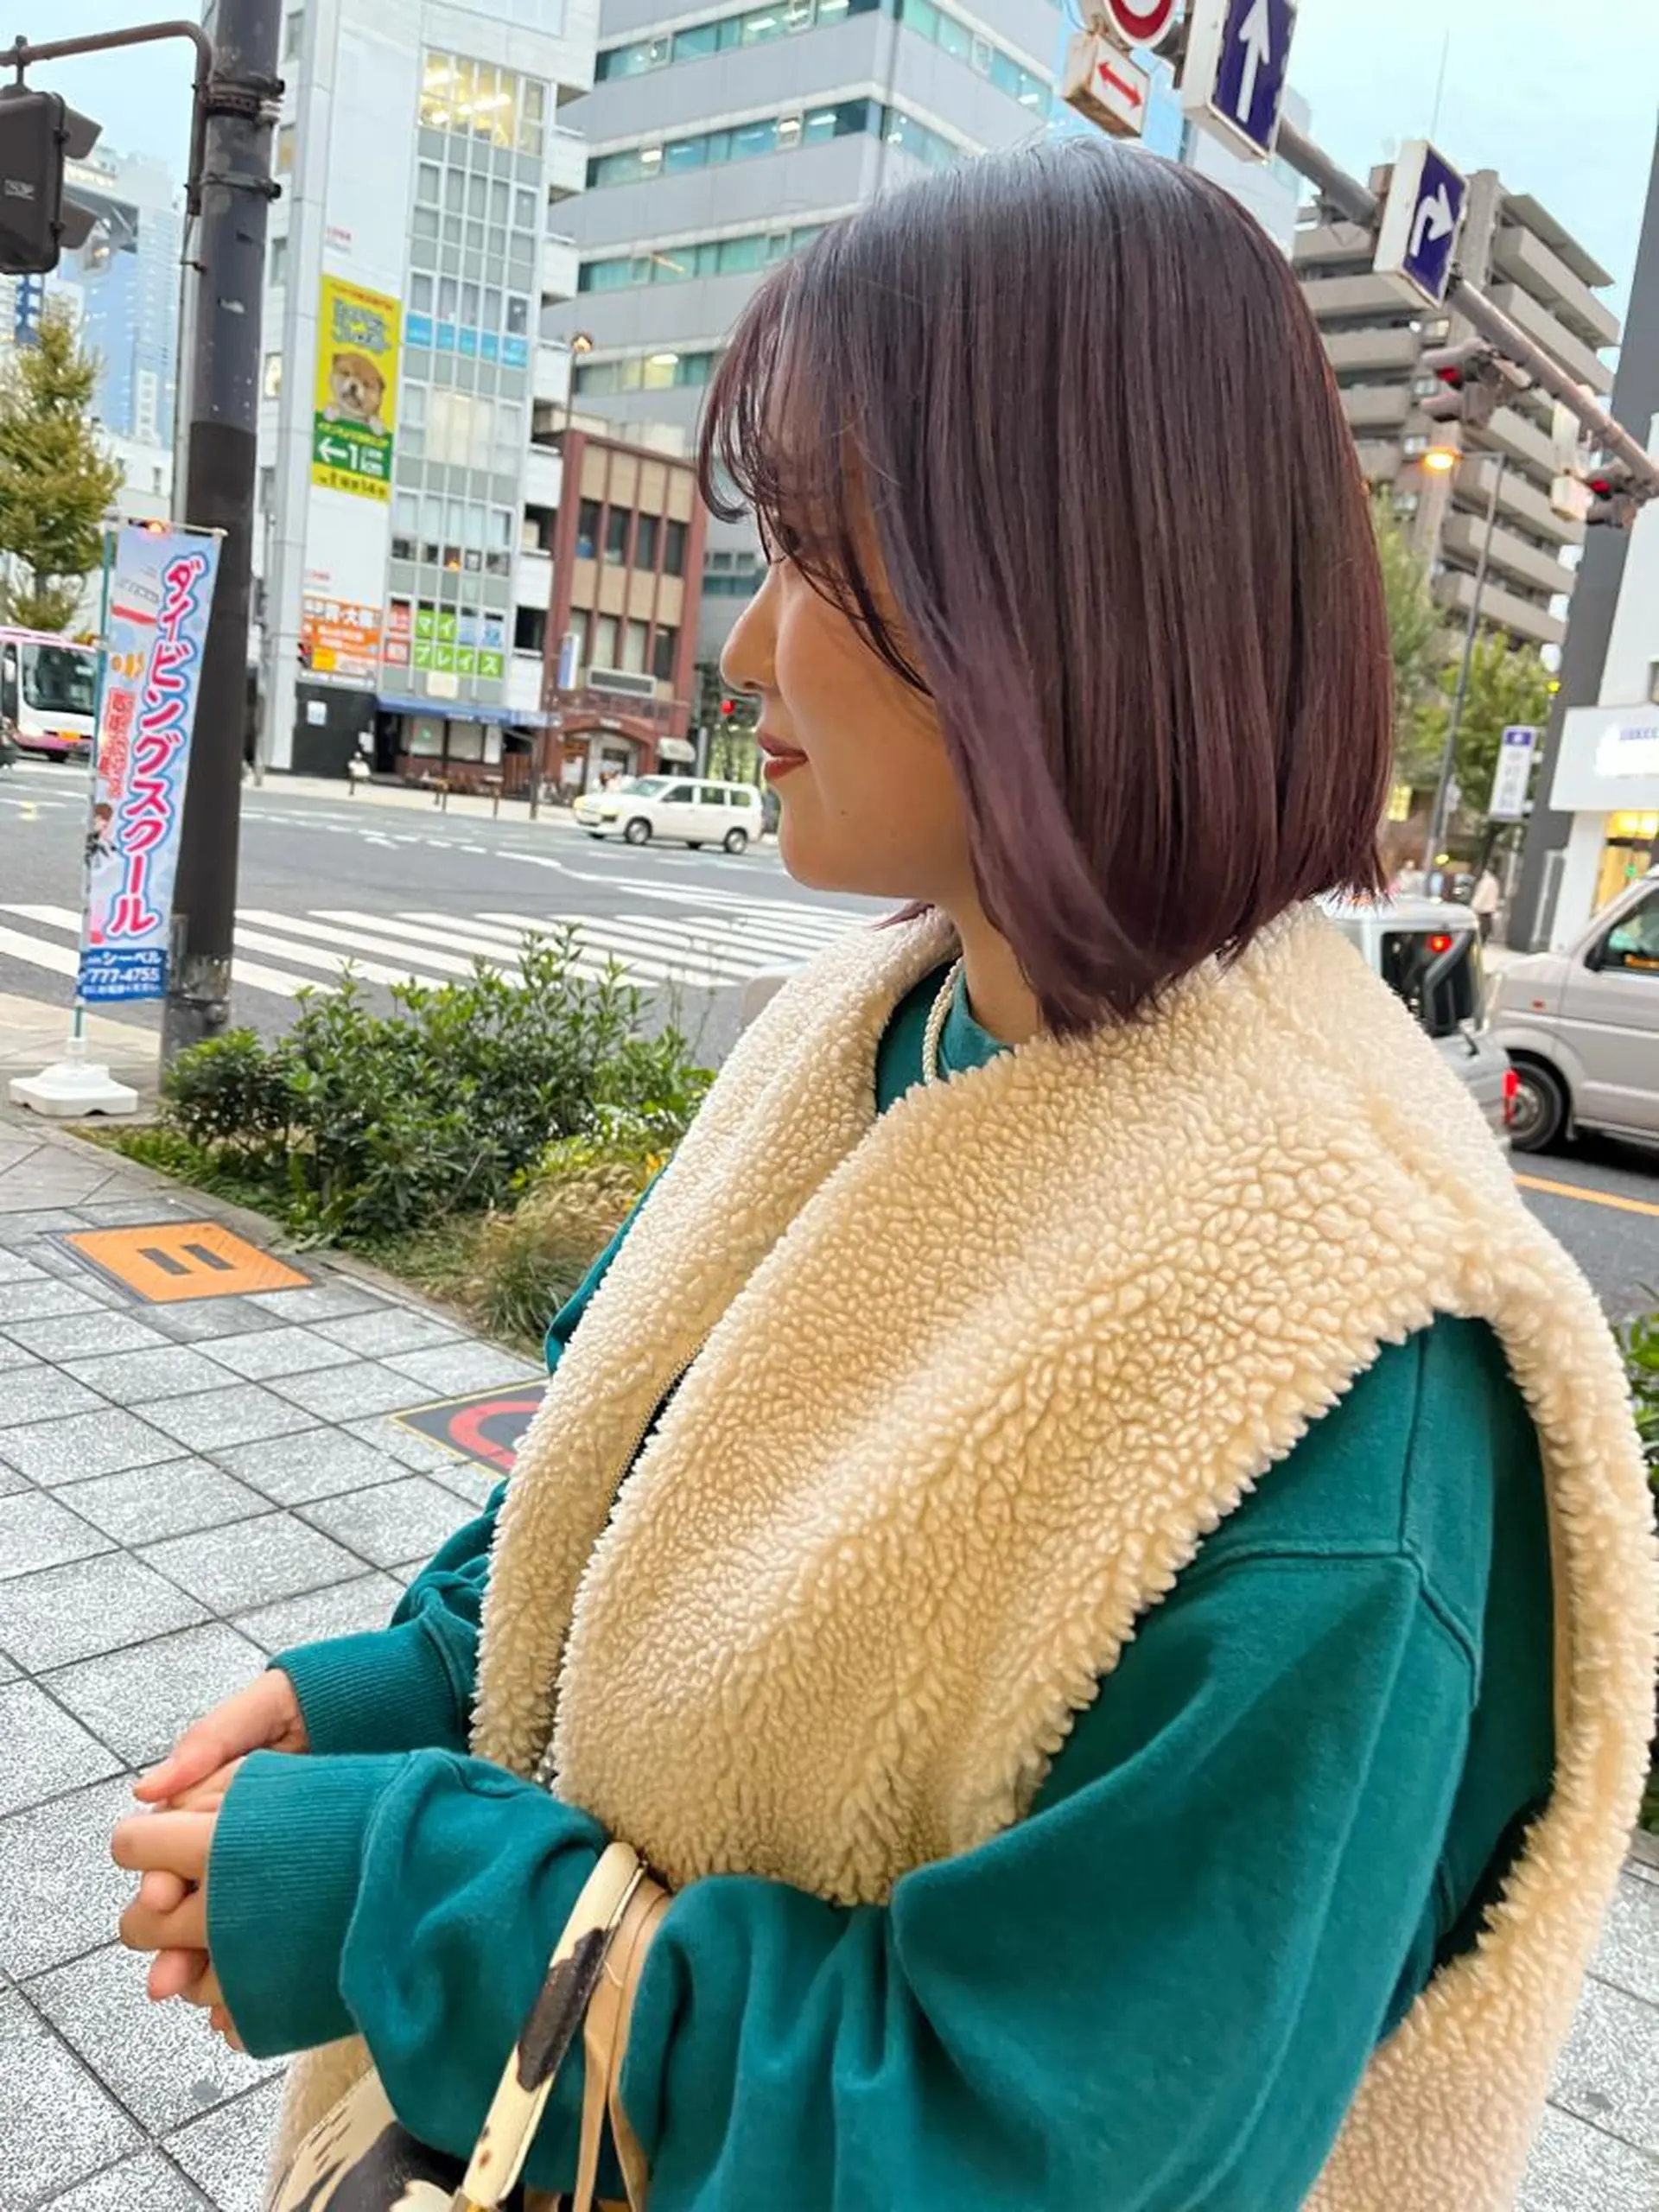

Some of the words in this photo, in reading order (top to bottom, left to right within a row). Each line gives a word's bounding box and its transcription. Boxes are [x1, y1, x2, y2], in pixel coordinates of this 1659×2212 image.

[418, 616, 456, 638] マイ
[109, 557, 204, 935] ダイビングスクール
